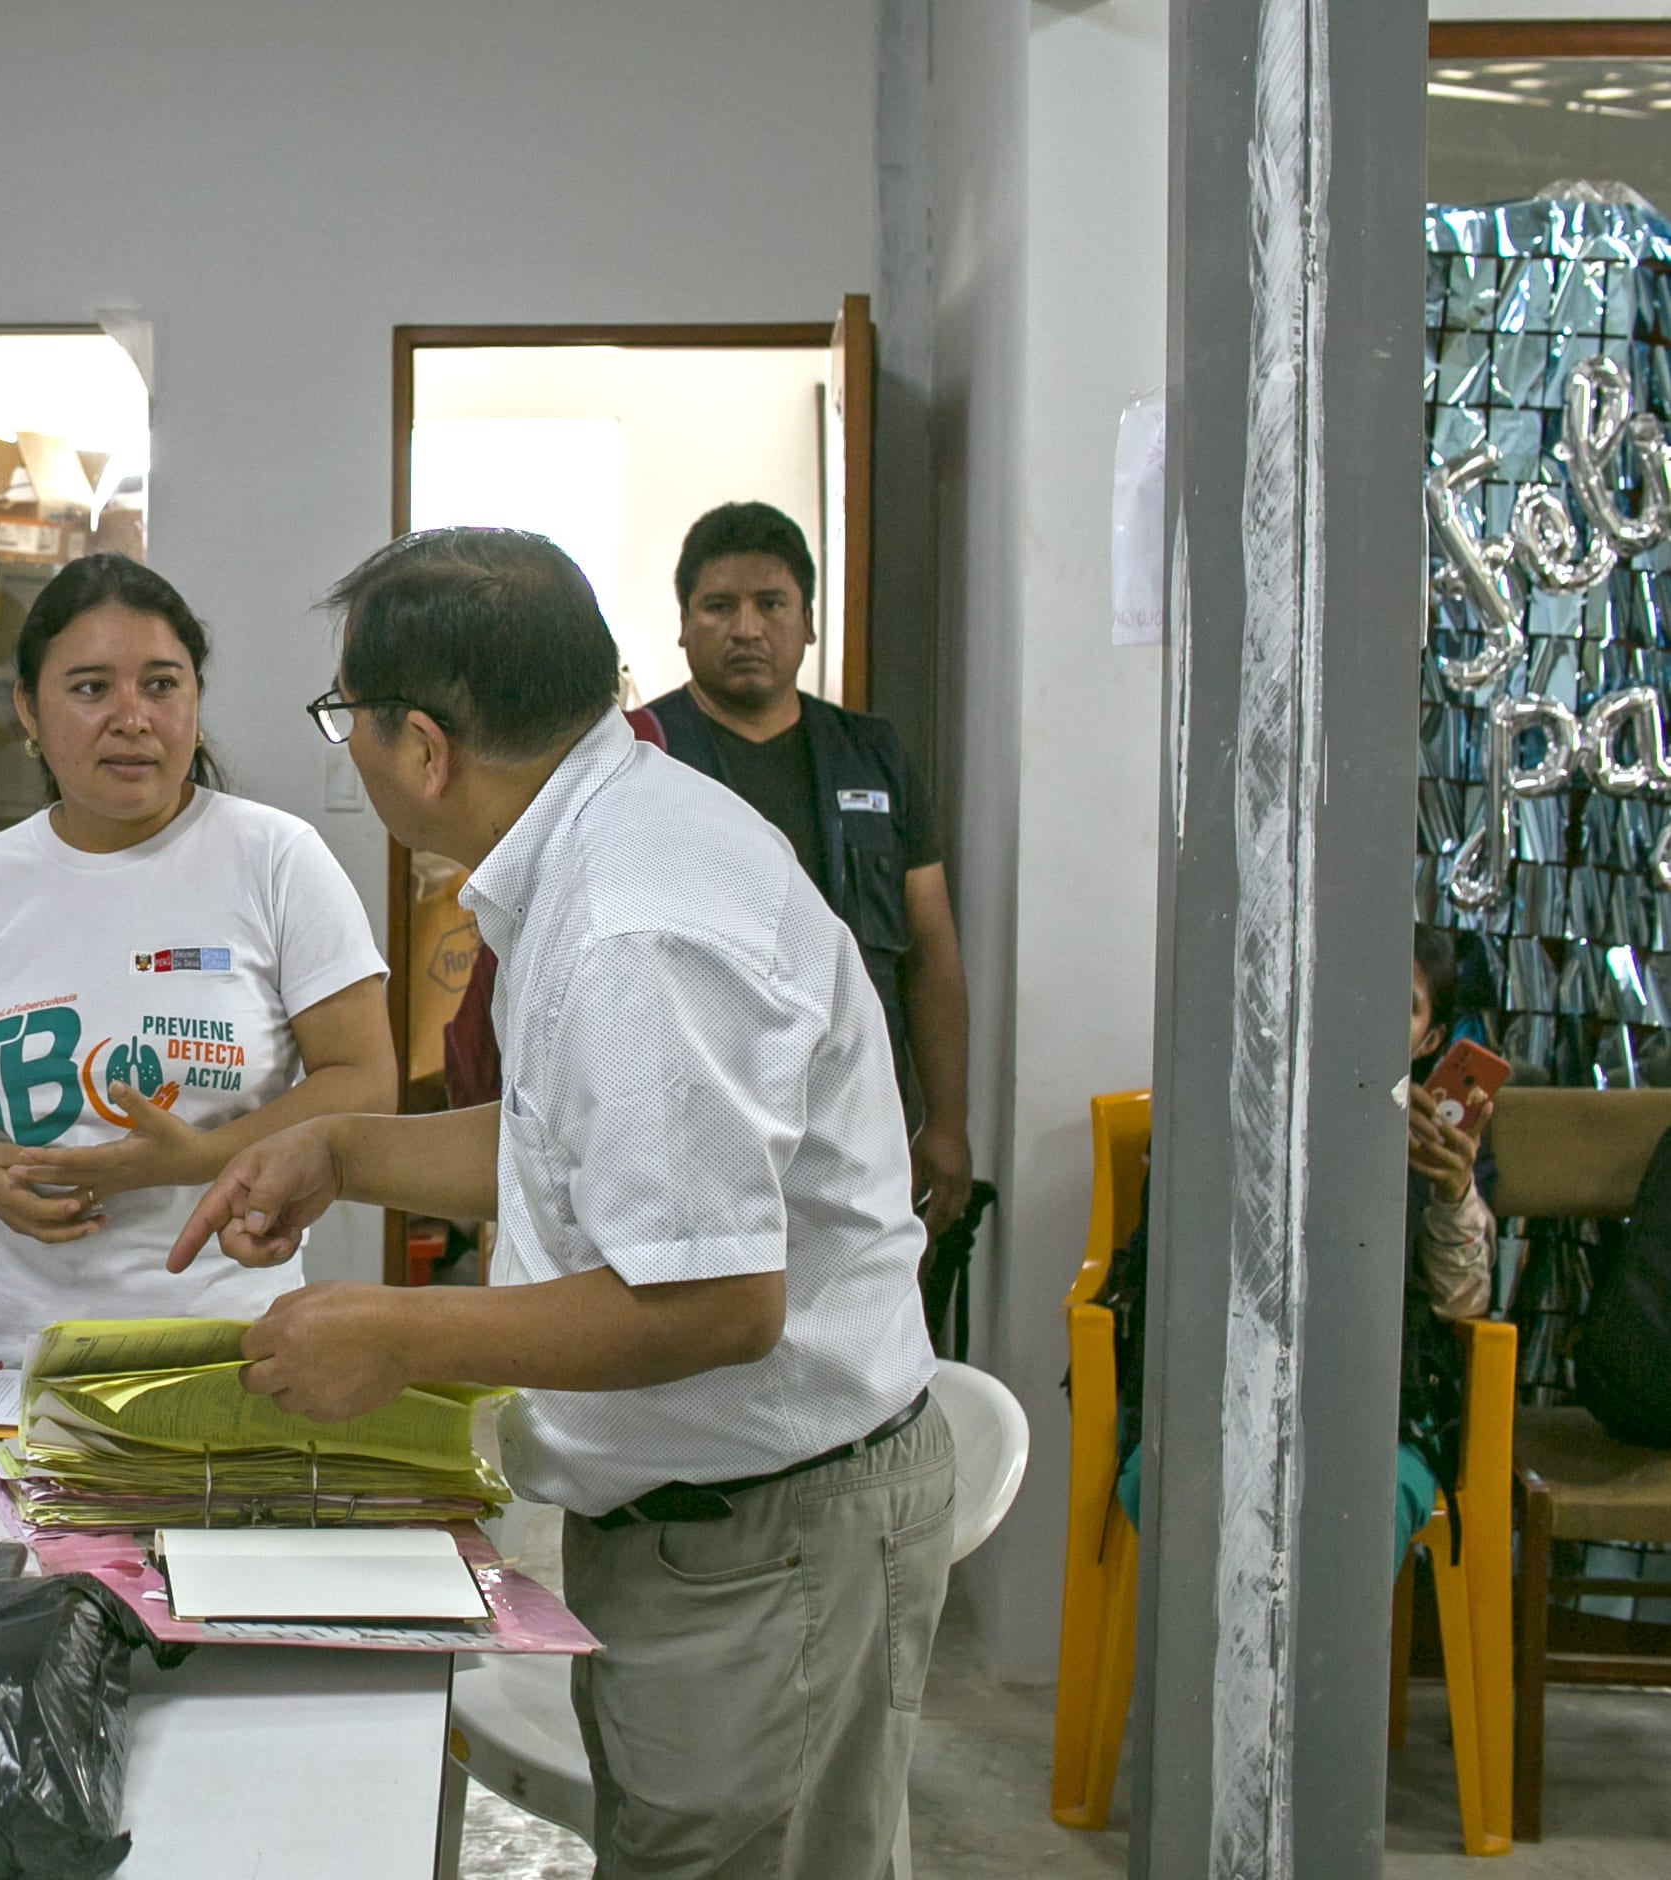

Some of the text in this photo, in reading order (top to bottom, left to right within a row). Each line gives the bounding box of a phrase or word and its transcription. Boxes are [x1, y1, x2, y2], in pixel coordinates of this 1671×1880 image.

[141, 1015, 235, 1043] PREVIENE
[167, 1038, 246, 1067] DETECTA
[184, 1065, 242, 1092] ACTÚA
